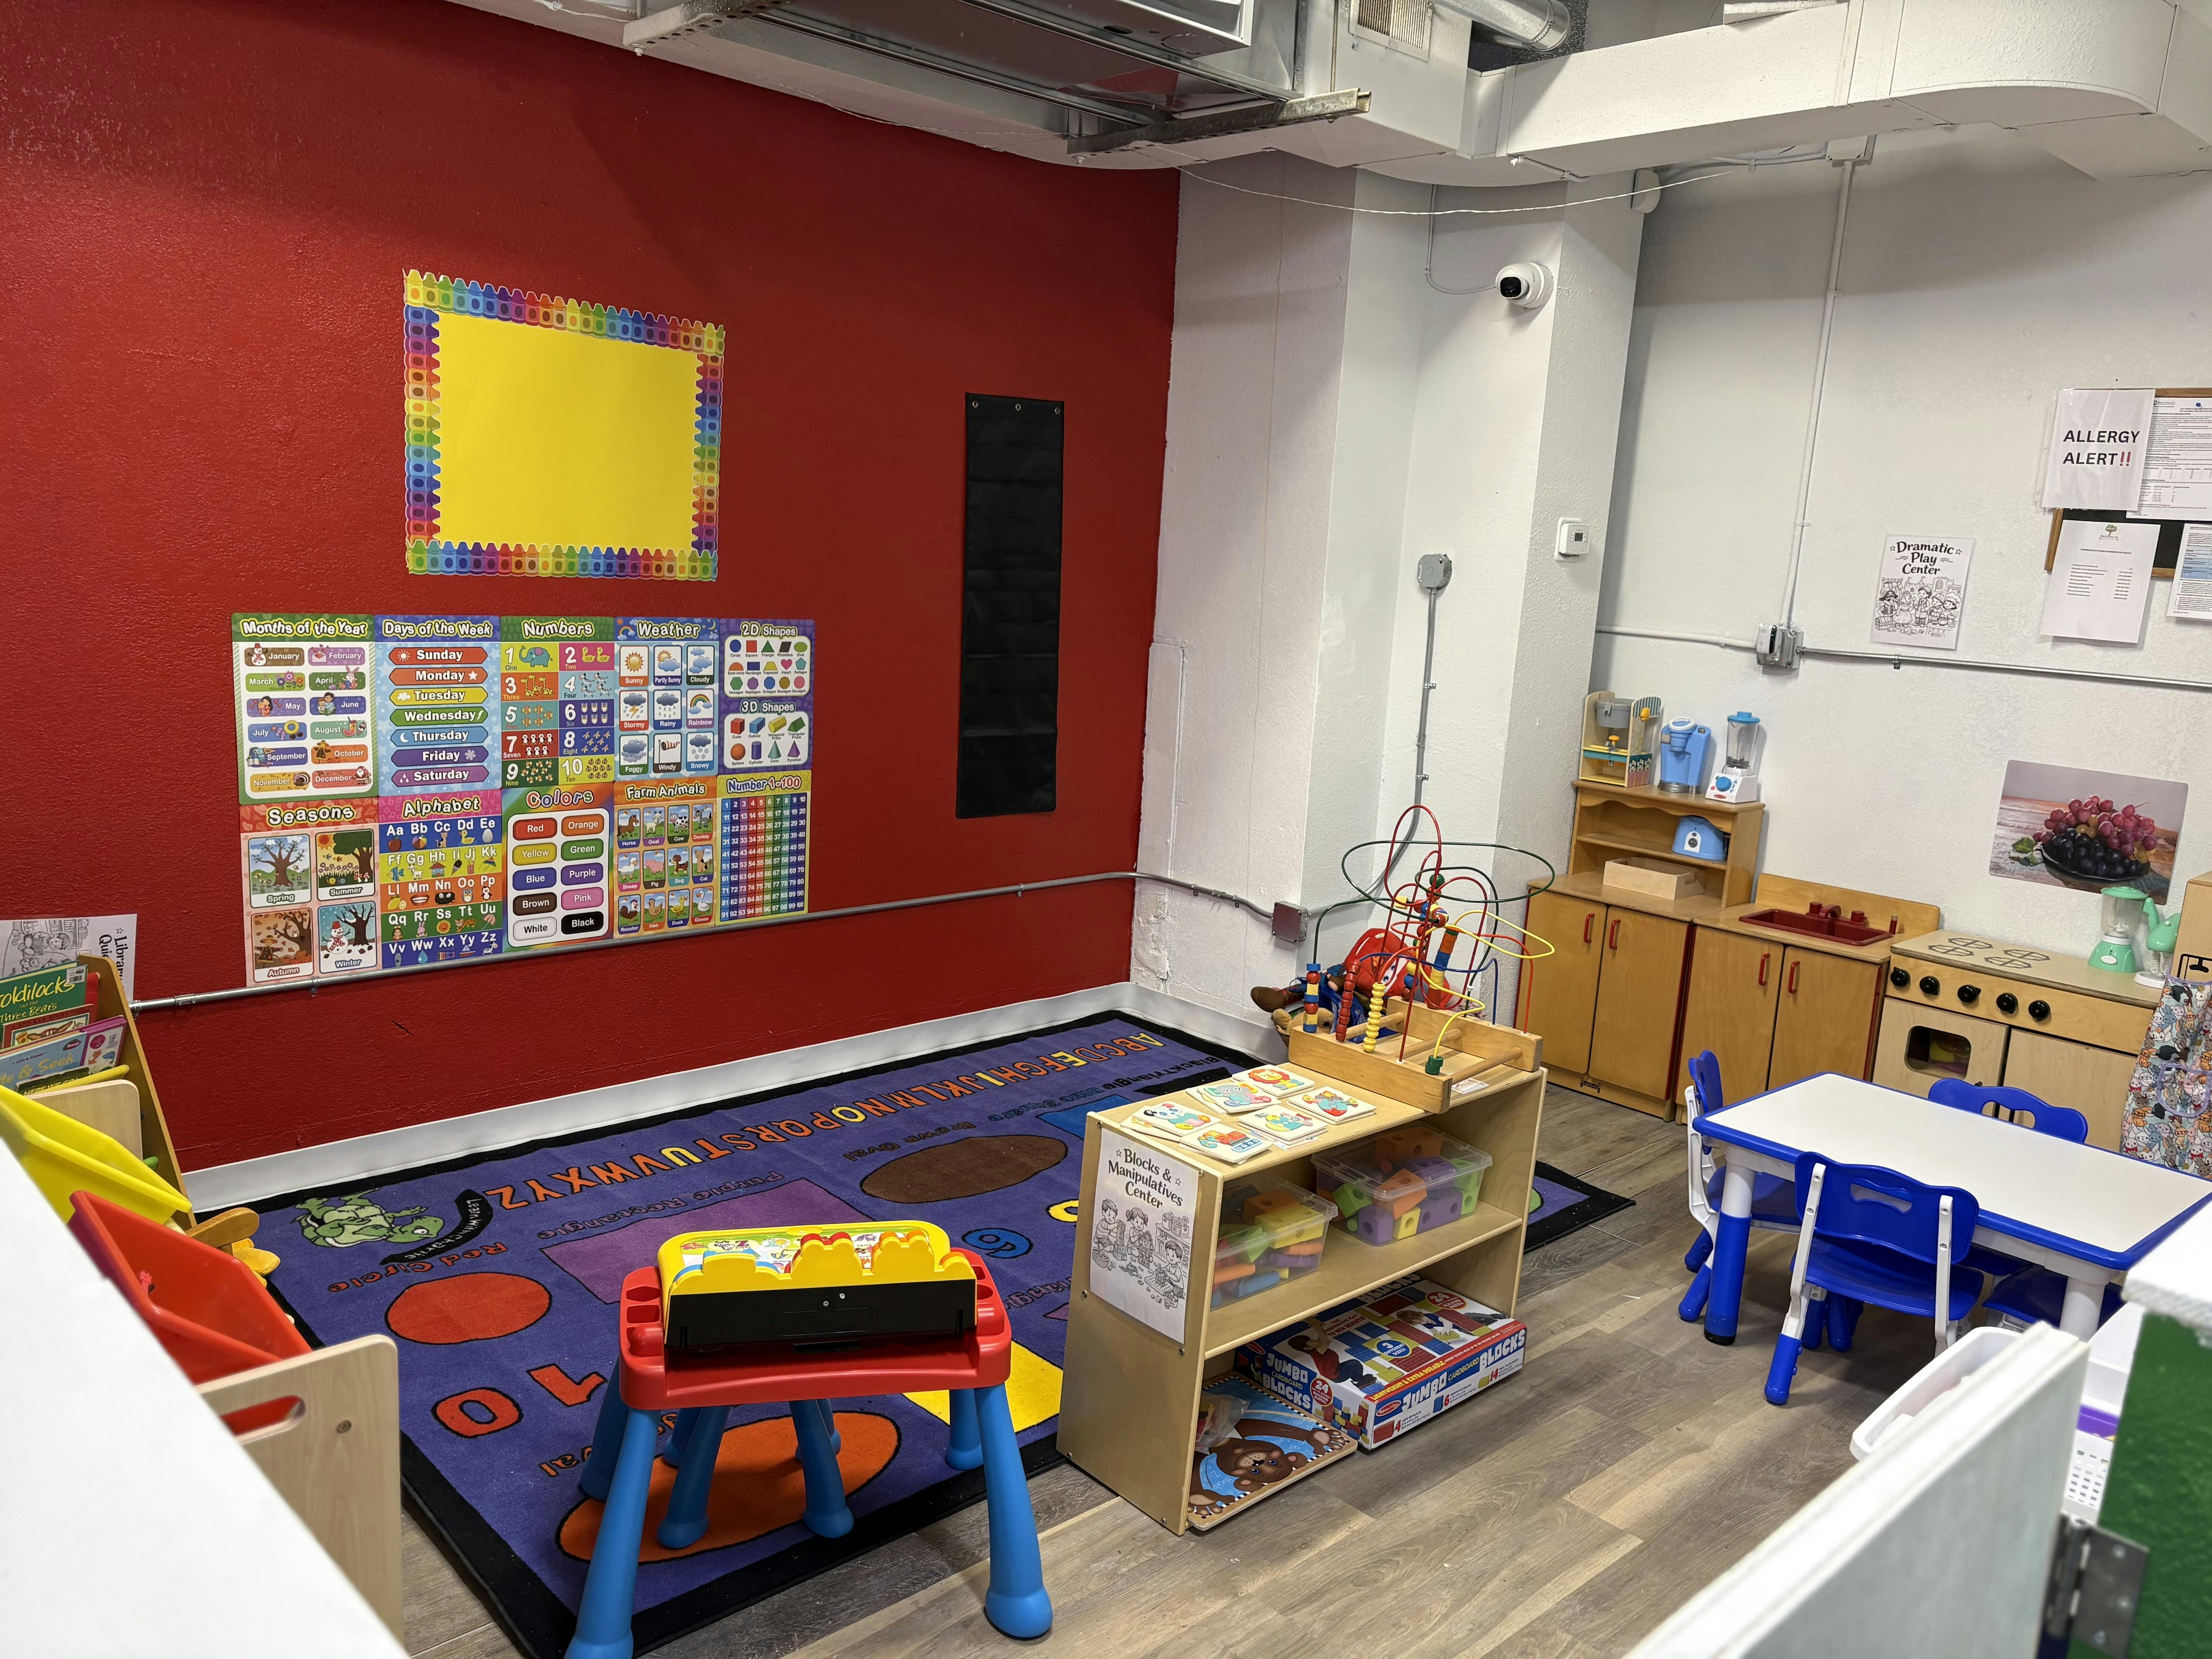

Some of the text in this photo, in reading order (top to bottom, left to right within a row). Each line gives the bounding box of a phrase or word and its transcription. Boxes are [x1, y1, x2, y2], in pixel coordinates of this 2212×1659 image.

[2063, 430, 2140, 444] ALLERGY
[2063, 451, 2131, 466] ALERT!!
[1896, 541, 1954, 555] Dramatic
[1911, 552, 1937, 566] Play
[1902, 563, 1940, 575] Center
[242, 621, 366, 636] Months of the Year
[385, 622, 491, 636] Days of the Week
[524, 621, 593, 637] Numbers
[639, 623, 699, 636] Weather
[742, 625, 796, 637] 2D Shapes
[269, 652, 299, 661] January
[329, 652, 361, 660] February
[417, 650, 462, 661] Sunday
[505, 647, 514, 664] 1
[565, 647, 577, 664] 2
[316, 677, 333, 685] April
[416, 671, 464, 682] Monday
[564, 676, 576, 692] 4
[505, 677, 517, 694] 3
[414, 691, 465, 702] Tuesday
[505, 706, 517, 723] 5
[565, 704, 576, 720] 6
[742, 702, 794, 712] 3D Shapes
[405, 710, 476, 722] Wednesday
[253, 729, 268, 737] July
[315, 726, 341, 734] August
[413, 731, 468, 742] Thursday
[507, 736, 517, 752] 7
[564, 732, 575, 747] 8
[267, 752, 306, 761] September
[422, 751, 460, 761] Friday
[507, 763, 519, 780] 9
[562, 759, 582, 776] 10
[254, 778, 290, 787] November
[414, 770, 469, 781] Saturday
[627, 784, 705, 799] Farm Animals
[728, 776, 800, 792] Number 1-100
[526, 790, 594, 808] Colors
[404, 797, 479, 817] Alphabet
[268, 807, 354, 825] Seasons
[387, 818, 495, 836] Aa Bb Cc Dd Ee
[568, 821, 598, 831] Orange
[570, 869, 596, 878] Purple
[268, 894, 294, 903] Spring
[331, 887, 362, 895] Summer
[574, 894, 591, 902] Pink
[522, 899, 549, 907] Brown
[524, 924, 548, 933] White
[572, 918, 594, 927] Black
[114, 936, 128, 981] Librar
[268, 967, 299, 977] Autumn
[0, 976, 75, 1008] oldilocks
[0, 1013, 26, 1023] Three
[29, 1003, 57, 1015] Bears
[988, 1087, 1104, 1122] Blue Square
[484, 1032, 1166, 1211] ABCDEFGHIJKLMNOPQRSTUVWXYZ
[842, 1121, 976, 1162] Brown Oval
[1123, 1149, 1171, 1183] Blocks &
[1108, 1160, 1183, 1206] Manipulatives
[1125, 1181, 1163, 1209] Center
[466, 1198, 482, 1220] Learn
[538, 1171, 785, 1239] Purple Rectangle
[404, 1233, 460, 1259] Charlie
[327, 1243, 509, 1293] Red Circle
[1430, 1293, 1450, 1302] 24
[1384, 1343, 1405, 1356] DIFFERENT
[1267, 1353, 1308, 1383] JUMBO
[1401, 1372, 1447, 1412] JUMBO
[1448, 1357, 1479, 1381] CARDBOARD
[1479, 1329, 1525, 1369] BLOCKS
[1489, 1368, 1499, 1382] 14
[1272, 1371, 1303, 1389] CARDBOARD
[1316, 1381, 1329, 1393] 24
[1370, 1381, 1404, 1401] LIGHTWEIGHT
[1408, 1371, 1424, 1382] EXTRA
[1424, 1360, 1445, 1374] DURABLE
[1263, 1374, 1311, 1409] BLOCKS
[431, 1363, 607, 1439] 10
[1444, 1395, 1450, 1407] 6
[1395, 1420, 1401, 1432] 4
